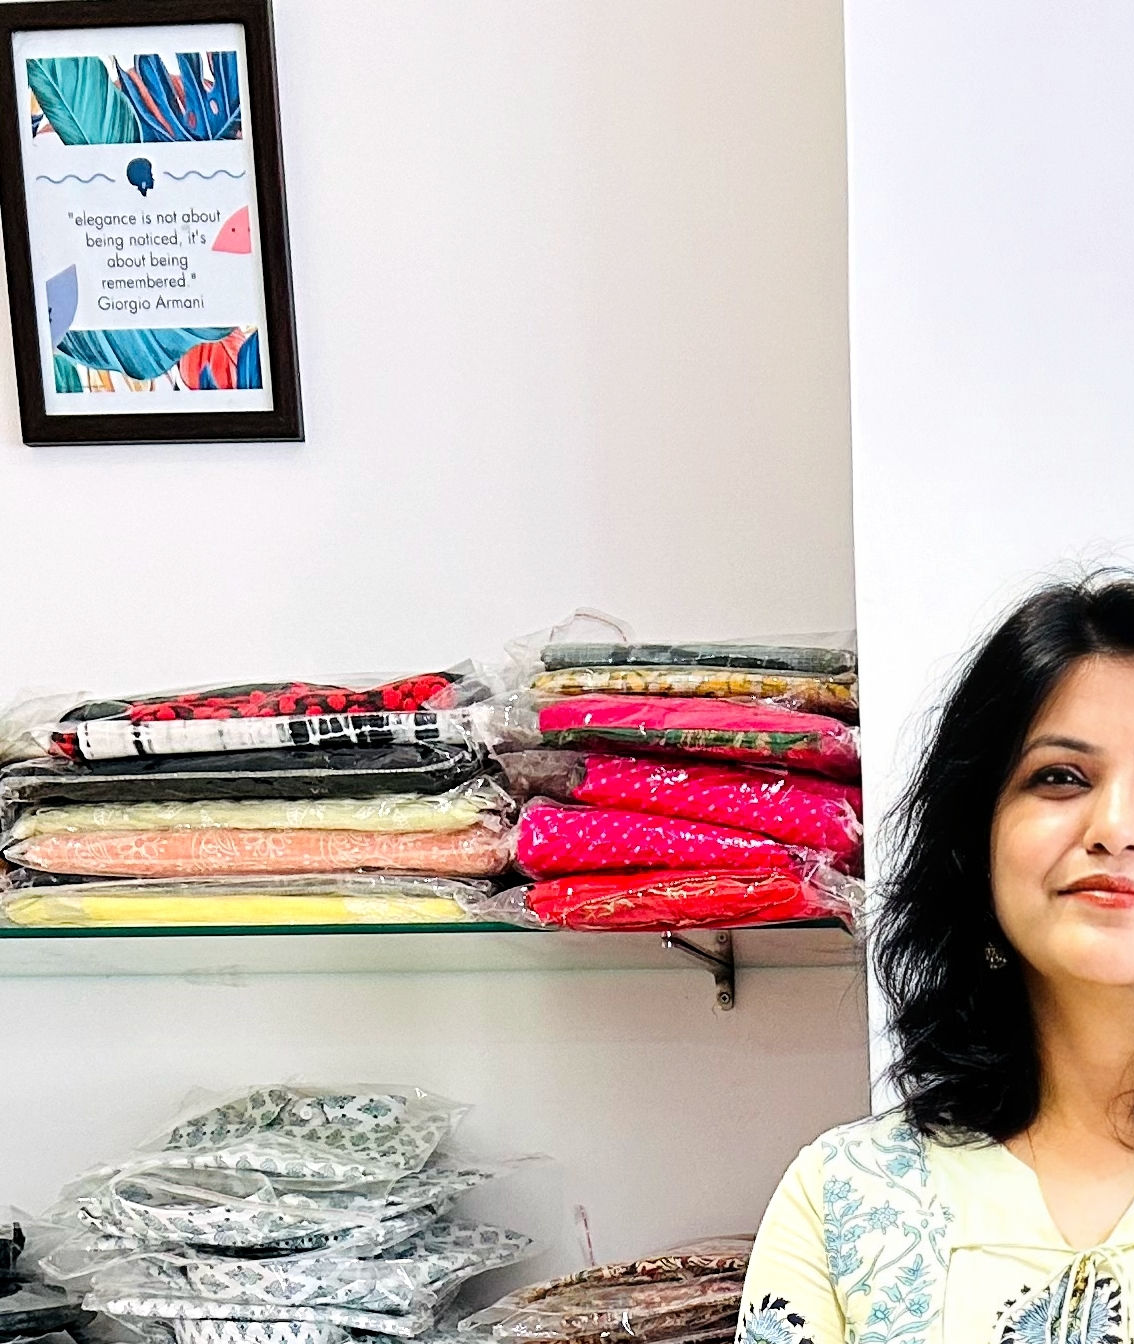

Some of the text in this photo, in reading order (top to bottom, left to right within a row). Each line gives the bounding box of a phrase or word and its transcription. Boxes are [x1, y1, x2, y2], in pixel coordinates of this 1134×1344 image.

[68, 208, 221, 230] "elegance is not about
[85, 229, 207, 250] being noticed, it's
[107, 251, 189, 271] about being
[101, 272, 197, 290] remembered."
[97, 294, 205, 315] Giorgio Armani
